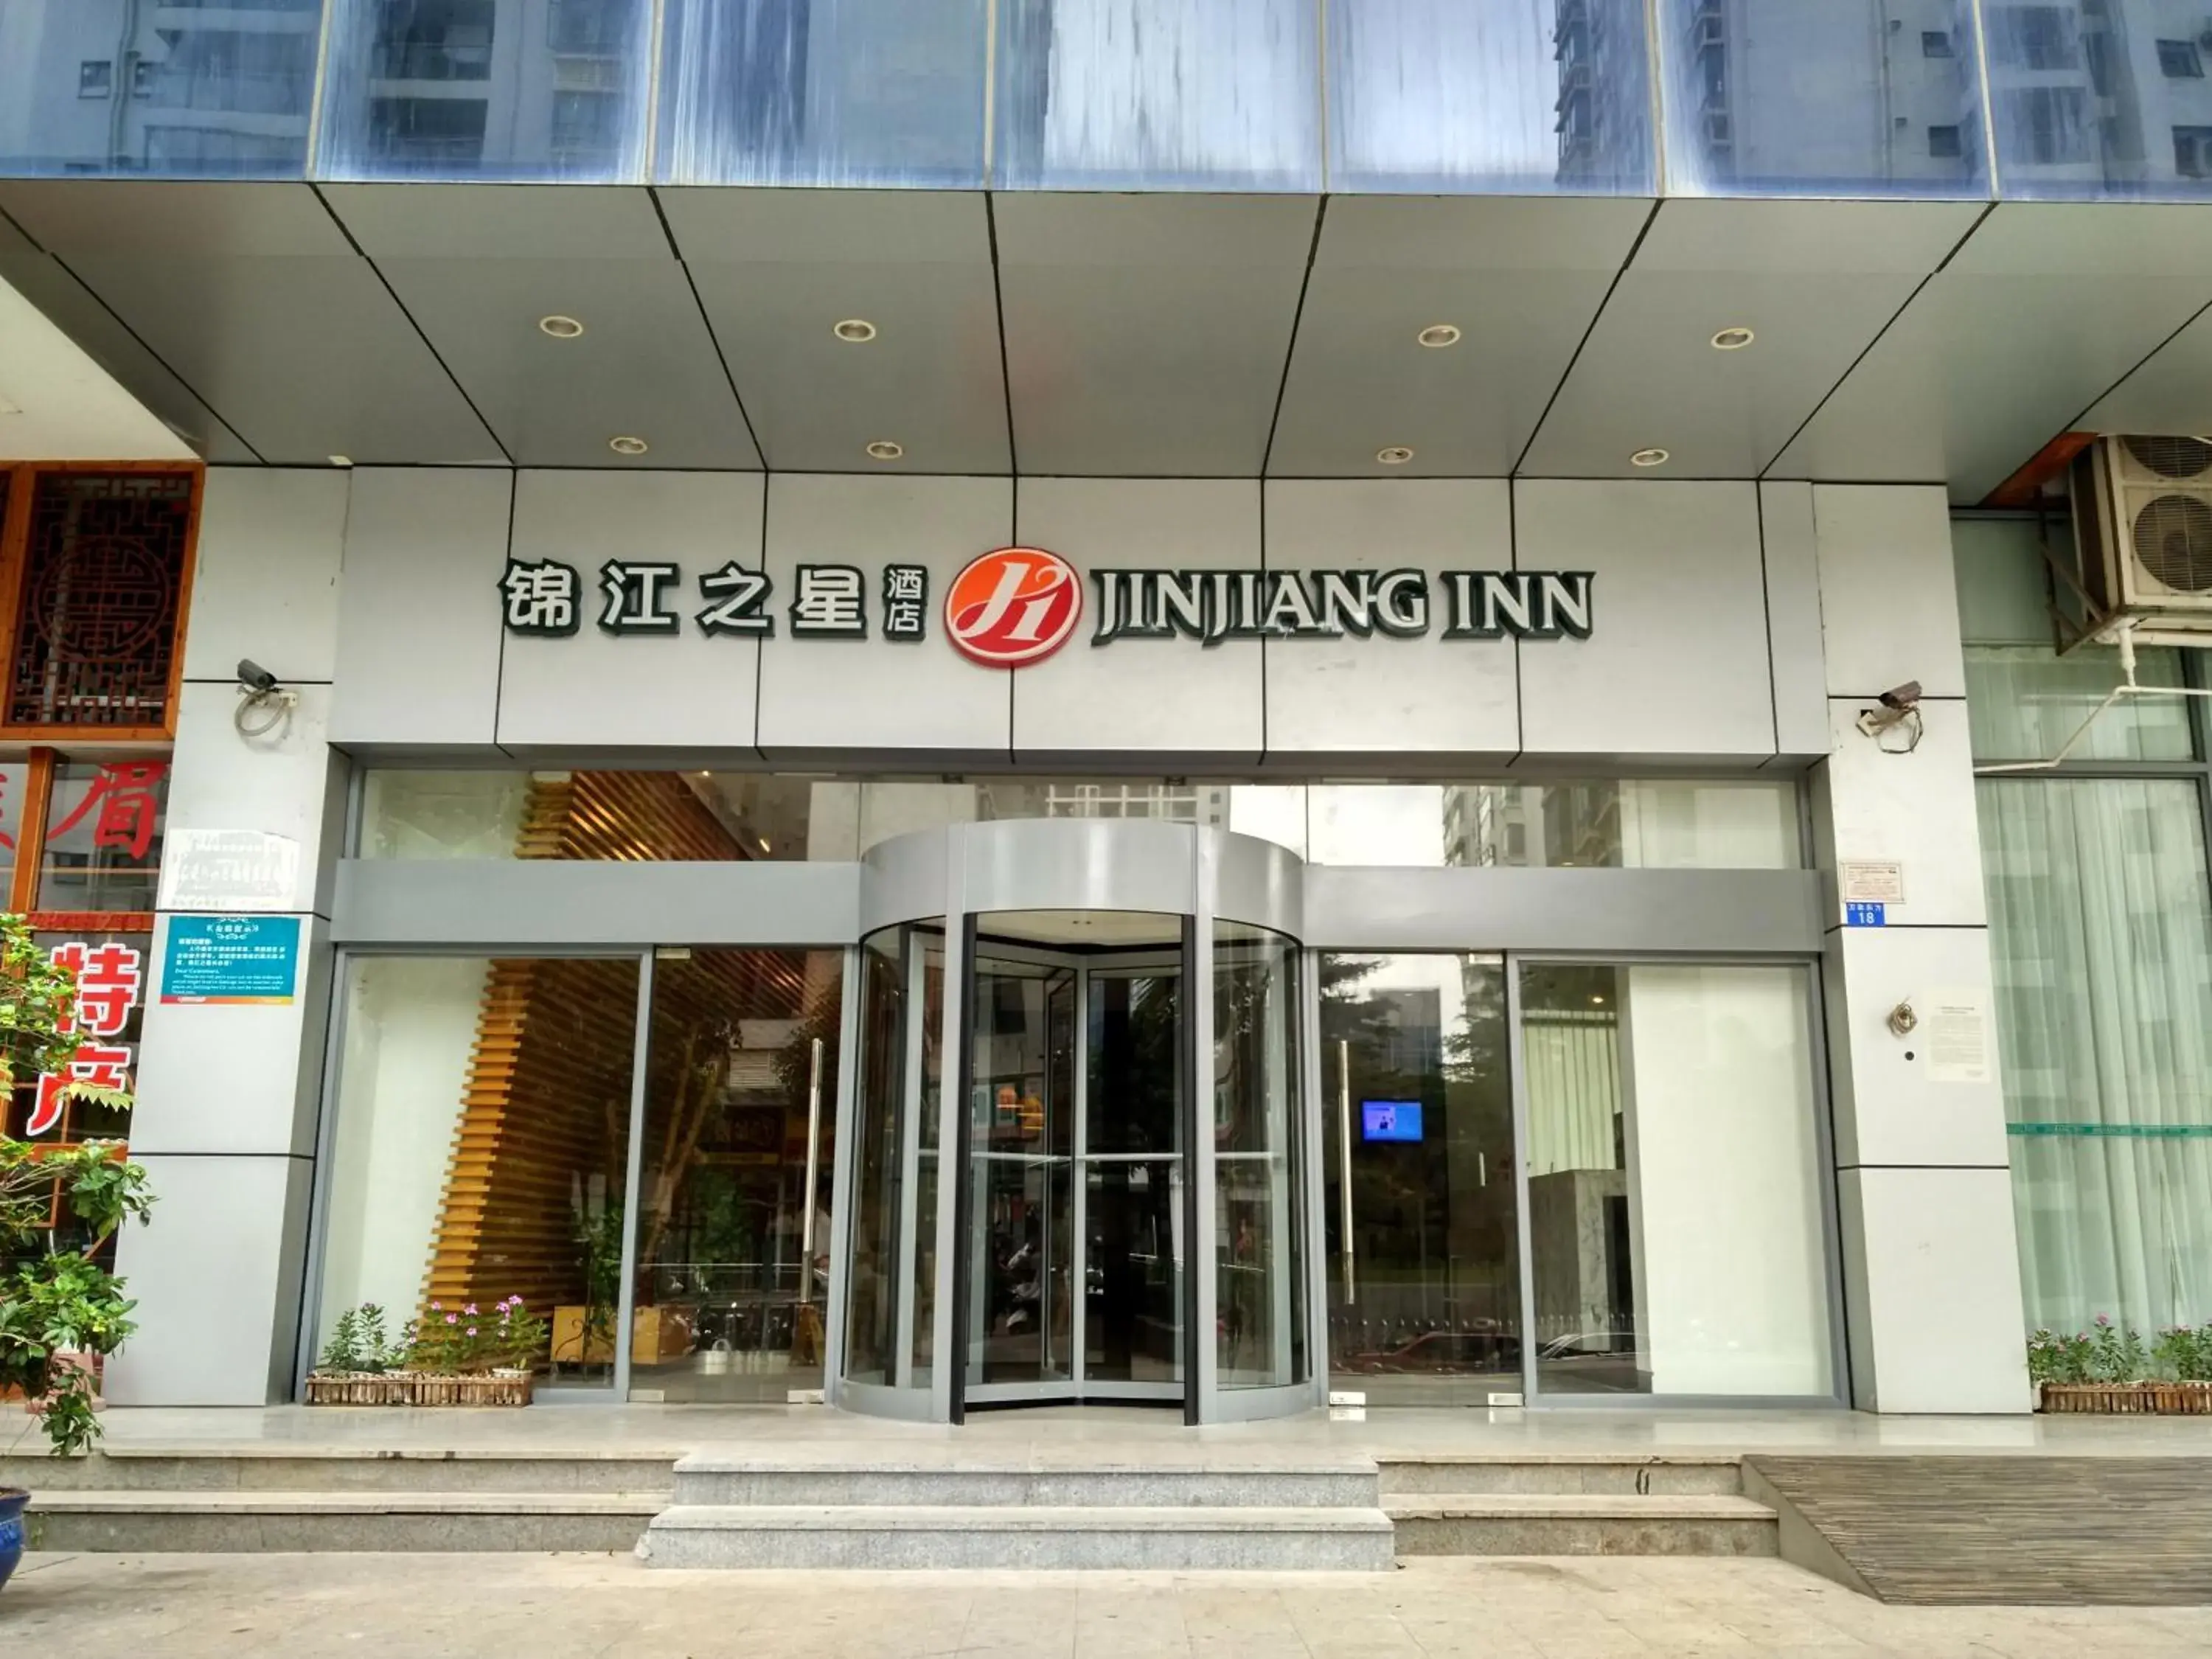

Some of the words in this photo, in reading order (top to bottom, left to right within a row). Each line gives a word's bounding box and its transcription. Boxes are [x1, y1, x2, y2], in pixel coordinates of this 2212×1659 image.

[500, 559, 866, 637] 锦江之星
[884, 565, 927, 639] 酒店
[1091, 568, 1429, 647] JINJIANG
[1440, 571, 1596, 639] INN
[1859, 912, 1875, 924] 18
